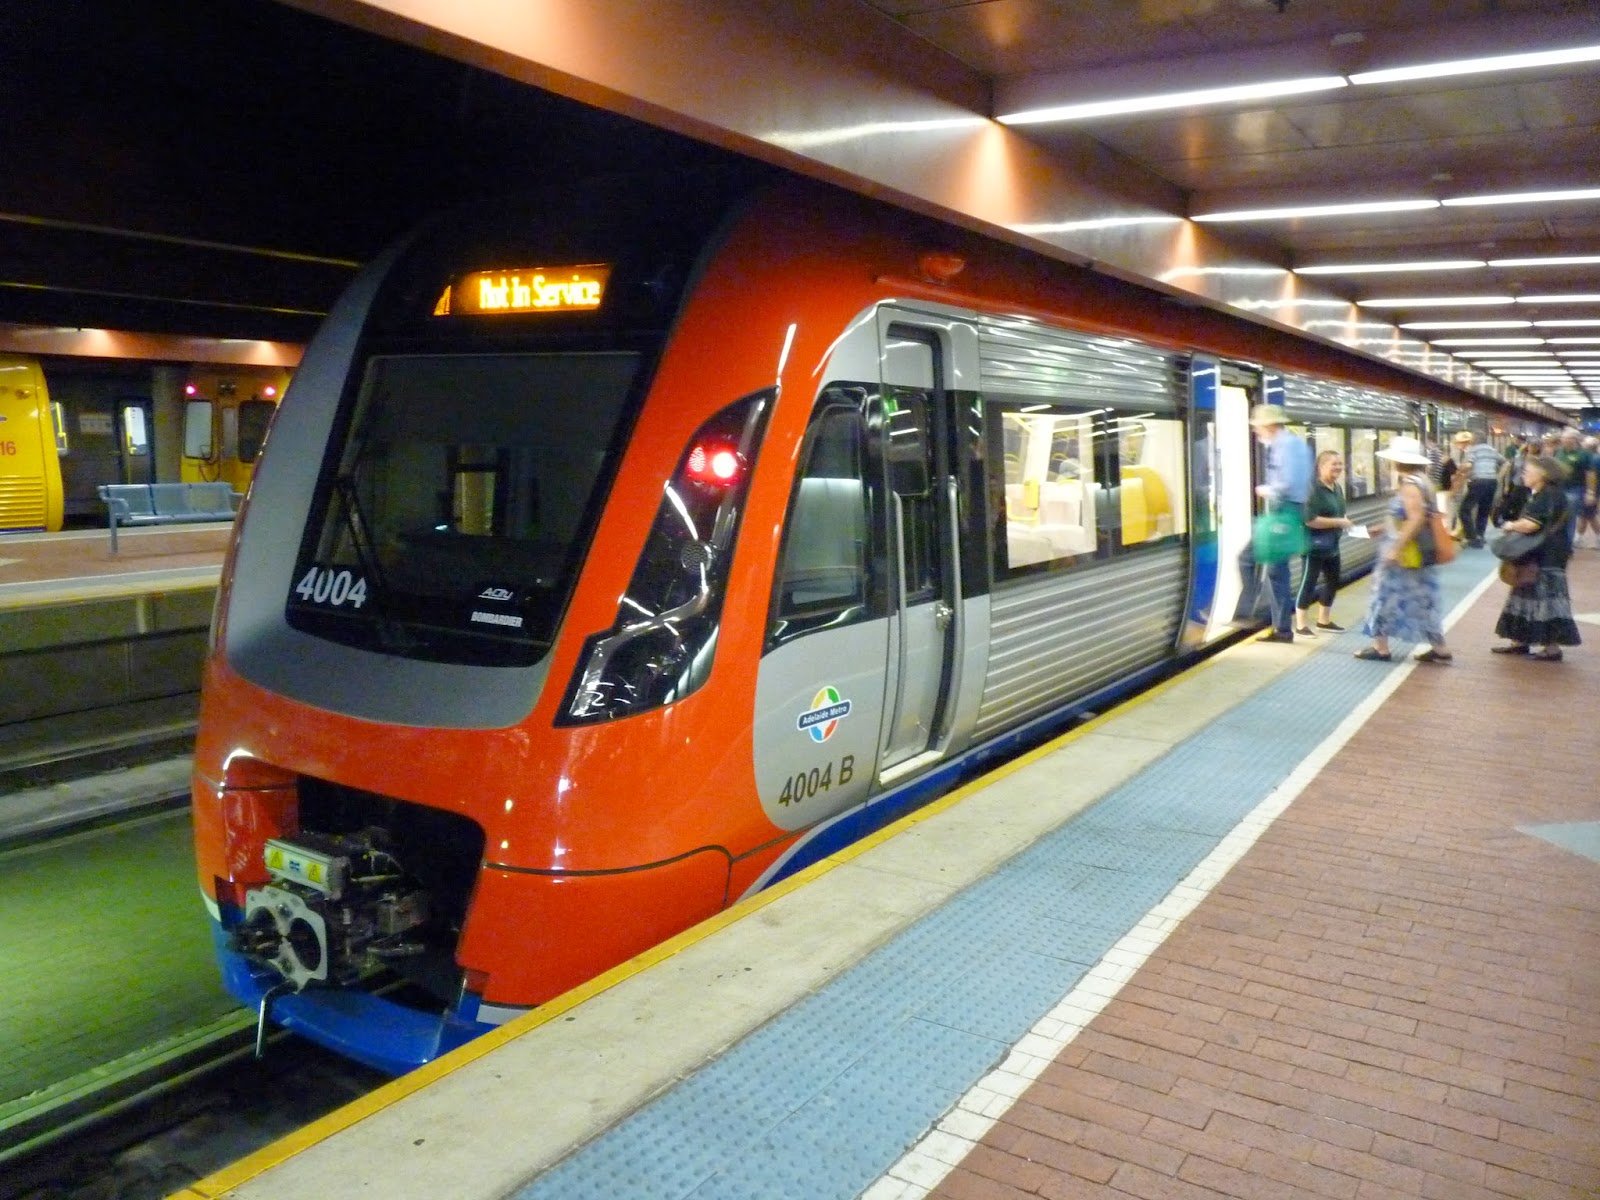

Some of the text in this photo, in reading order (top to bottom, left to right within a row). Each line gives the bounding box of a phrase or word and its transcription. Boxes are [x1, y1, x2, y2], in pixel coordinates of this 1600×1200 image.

[479, 277, 509, 309] Not
[532, 274, 601, 307] Service
[296, 566, 367, 609] 4004
[802, 705, 847, 726] Adelaide Metro
[778, 754, 855, 807] 4004 B
